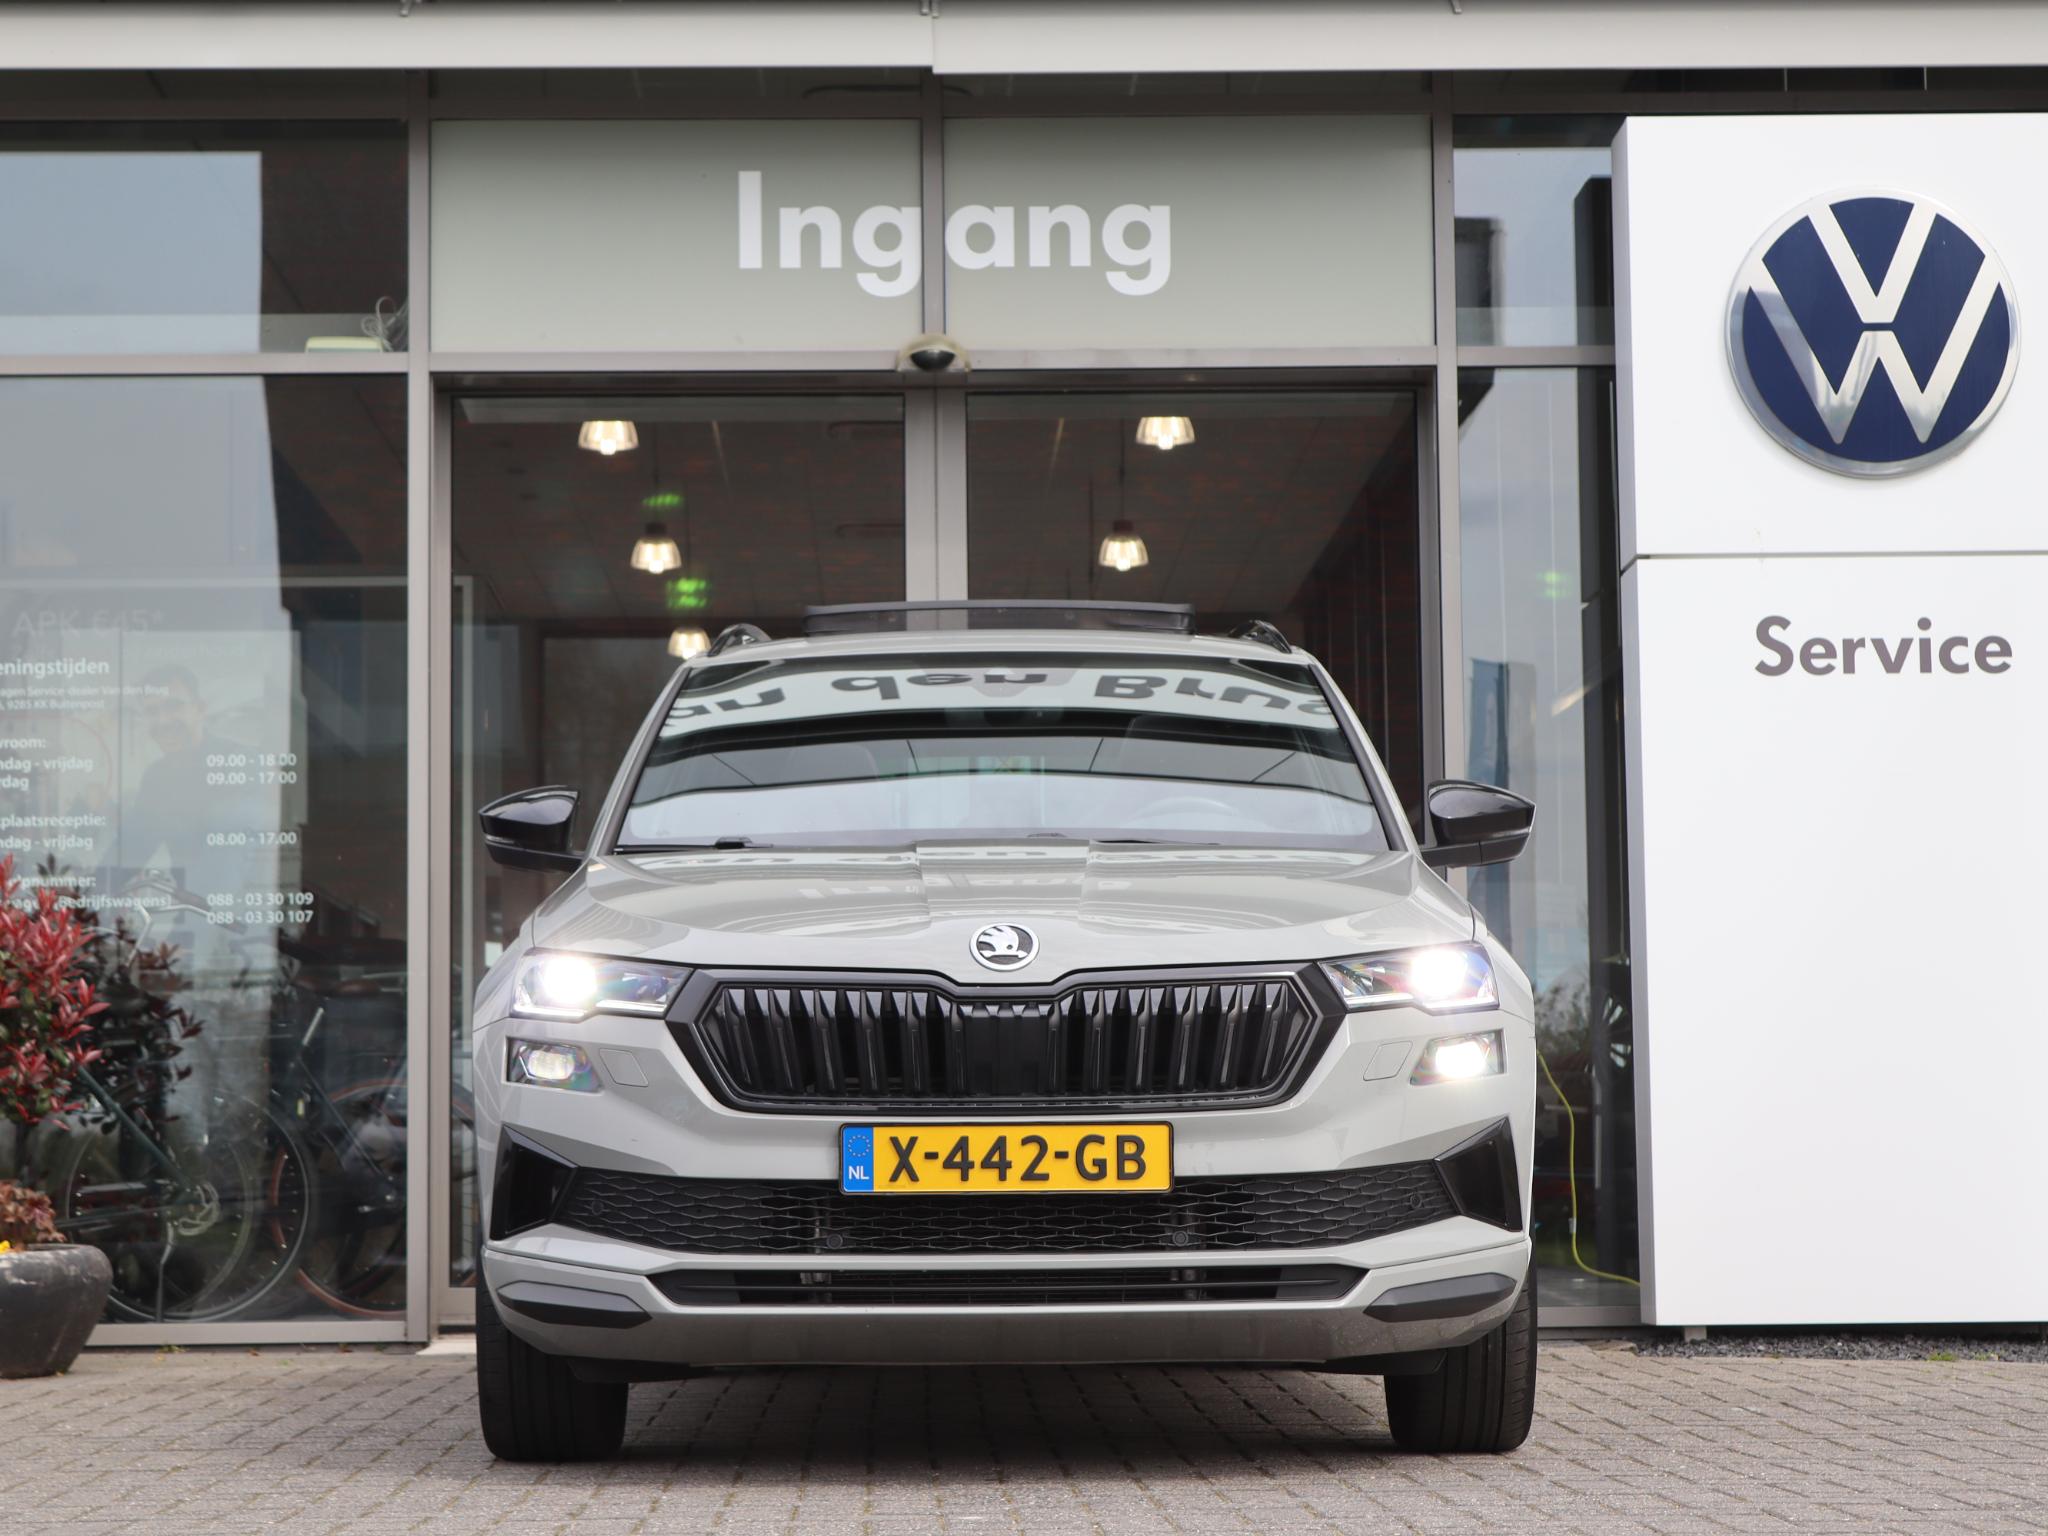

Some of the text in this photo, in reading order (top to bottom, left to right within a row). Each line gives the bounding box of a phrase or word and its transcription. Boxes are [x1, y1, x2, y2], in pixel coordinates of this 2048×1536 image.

[738, 171, 1170, 297] Ingang
[1755, 615, 2013, 677] Service
[42, 756, 94, 773] vrijdag
[206, 753, 246, 767] 09.00
[259, 753, 297, 766] 1800
[206, 771, 246, 785] 09.00
[259, 771, 297, 784] 1700
[0, 813, 106, 831] plaatsreceptie:
[42, 835, 94, 851] vrijdag
[206, 832, 246, 846] 08.00
[259, 831, 297, 845] 17.00
[207, 893, 234, 906] 088
[245, 893, 262, 906] 03
[266, 892, 284, 905] 30
[288, 892, 314, 905] 109
[207, 911, 234, 924] 088
[245, 911, 262, 924] 03
[266, 911, 284, 923] 30
[288, 910, 314, 923] 107
[848, 1134, 1147, 1183] NL X-442-GB
